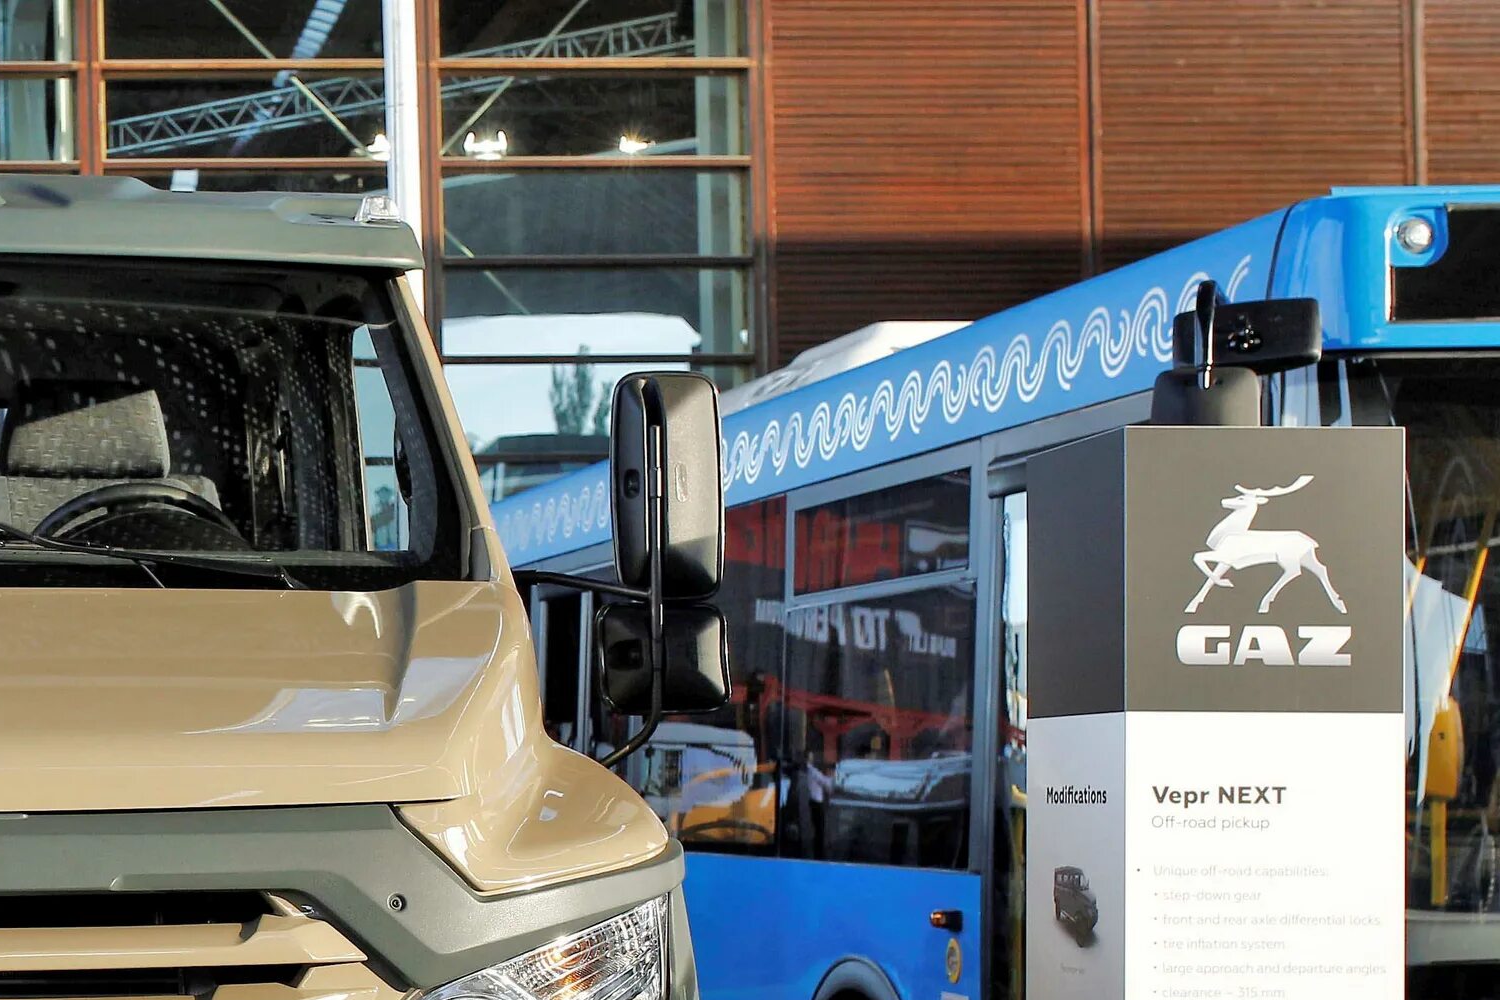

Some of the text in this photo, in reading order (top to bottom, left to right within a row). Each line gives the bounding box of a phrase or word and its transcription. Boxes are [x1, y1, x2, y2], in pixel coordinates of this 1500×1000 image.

[1176, 625, 1352, 666] GAZ
[1046, 785, 1107, 804] Modifications
[1152, 786, 1288, 809] Vepr NEXT
[1151, 815, 1271, 831] Off-road pickup
[1153, 865, 1197, 878] Unique
[1200, 865, 1252, 877] off-road
[1163, 890, 1261, 904] step-down gear
[1163, 913, 1382, 926] front and rear axle differential locks
[1163, 939, 1184, 950] tire
[1240, 940, 1285, 952] system
[1162, 962, 1387, 977] large approach and departure angles
[1162, 988, 1222, 998] clearance
[1261, 989, 1285, 998] mm
